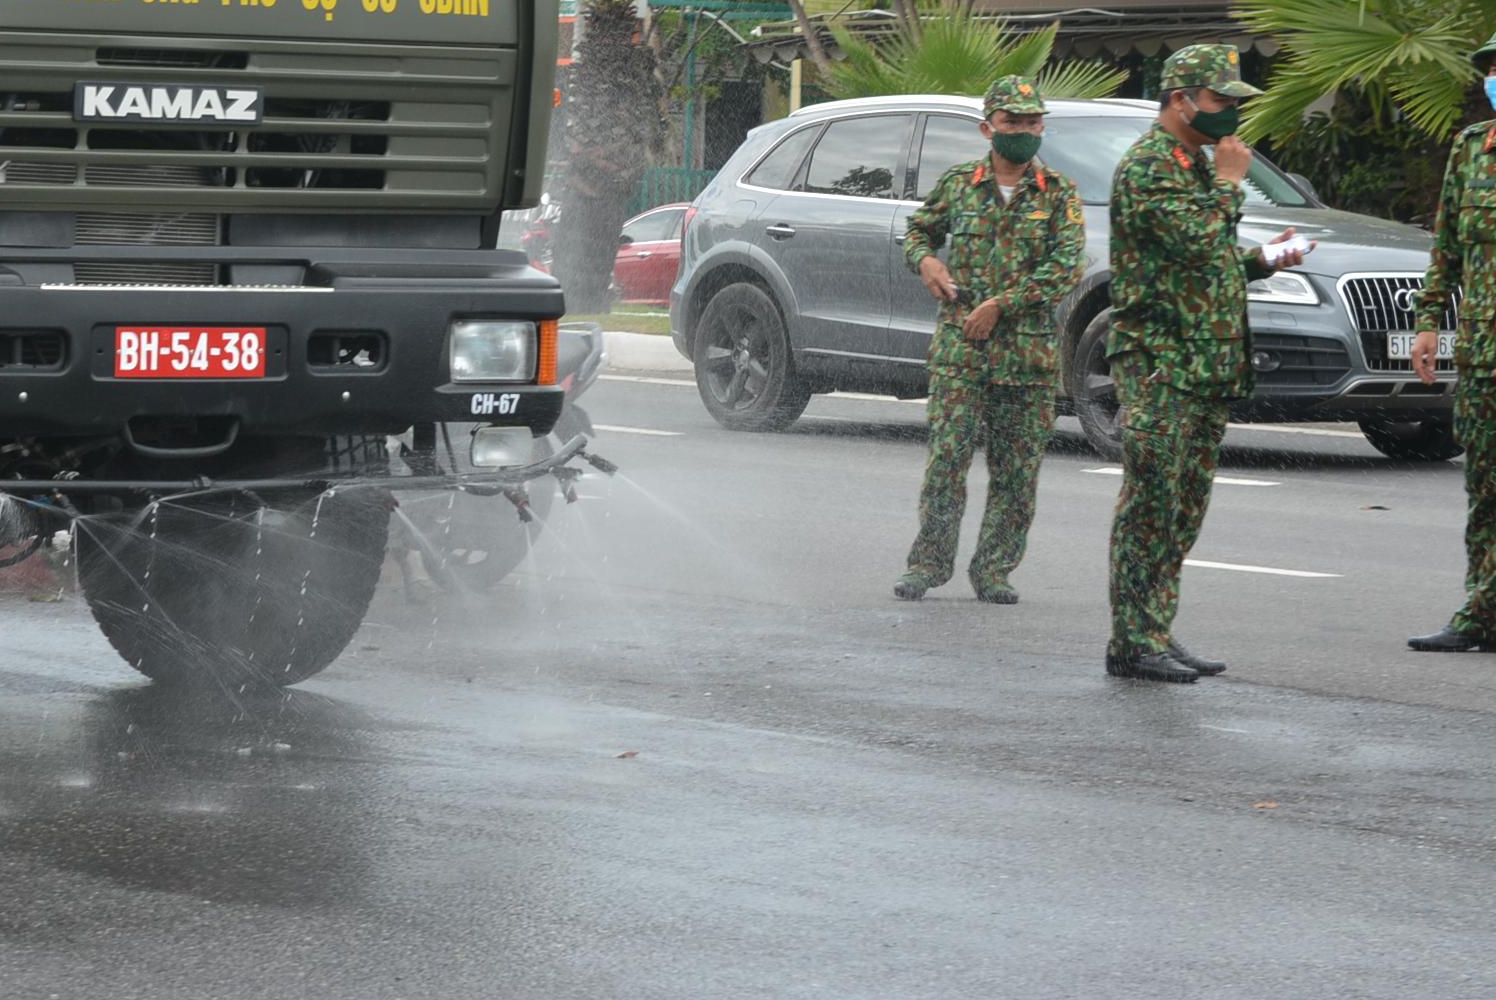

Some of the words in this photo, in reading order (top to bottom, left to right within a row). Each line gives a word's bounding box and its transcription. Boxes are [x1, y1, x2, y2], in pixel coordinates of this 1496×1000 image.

[82, 85, 258, 121] KAMAZ
[119, 331, 260, 371] BH-54-38
[470, 393, 521, 415] CH-67
